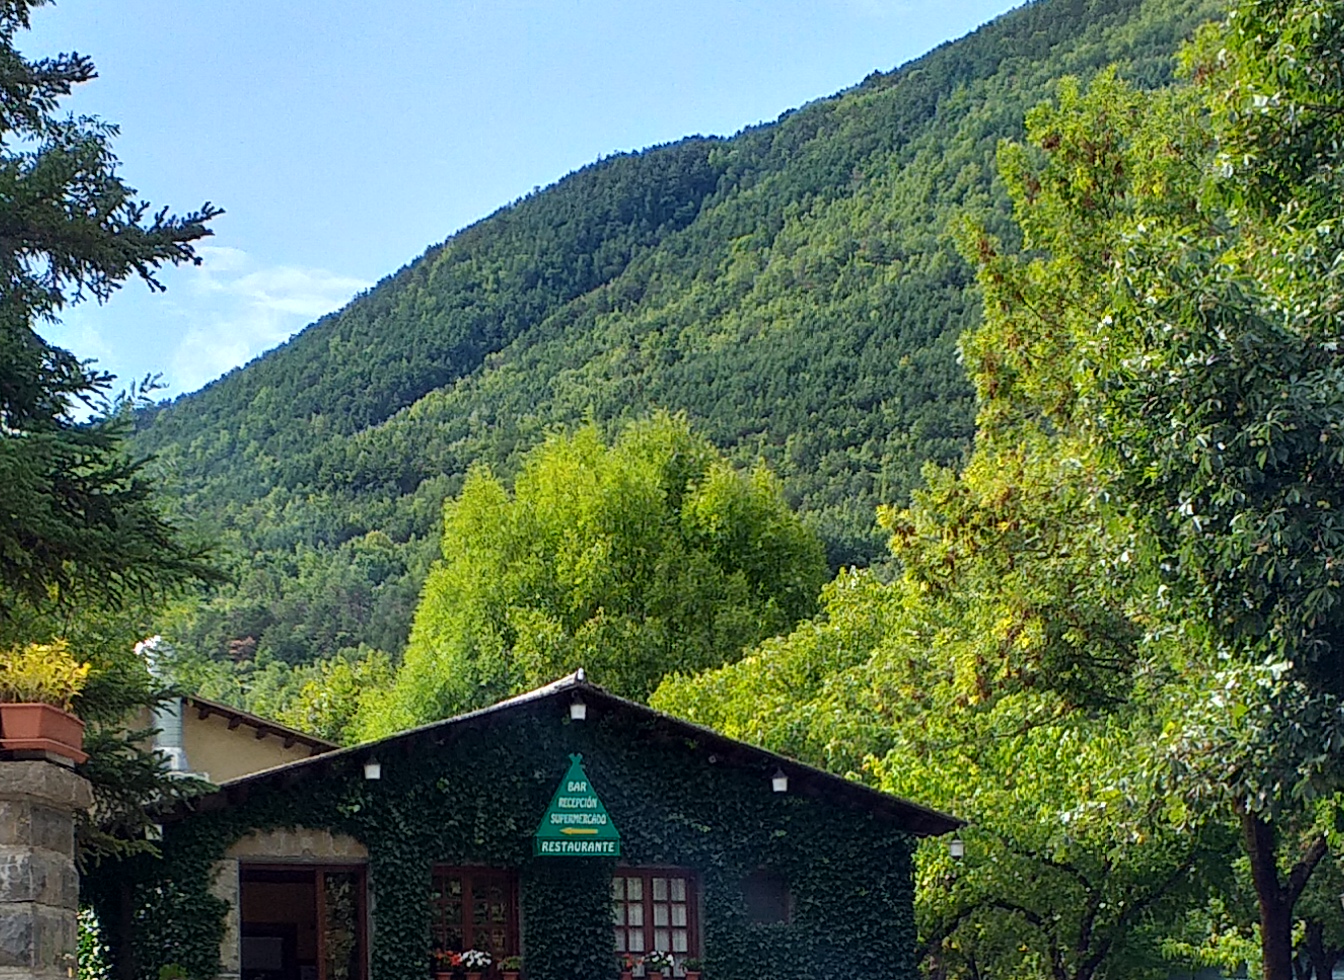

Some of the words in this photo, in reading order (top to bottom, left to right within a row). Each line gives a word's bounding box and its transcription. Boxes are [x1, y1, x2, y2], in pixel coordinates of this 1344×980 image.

[567, 781, 587, 792] BAR
[558, 796, 598, 808] RECEPCIÓN
[550, 813, 607, 825] SUPERMERCADO
[541, 841, 615, 853] RESTAURANTE
